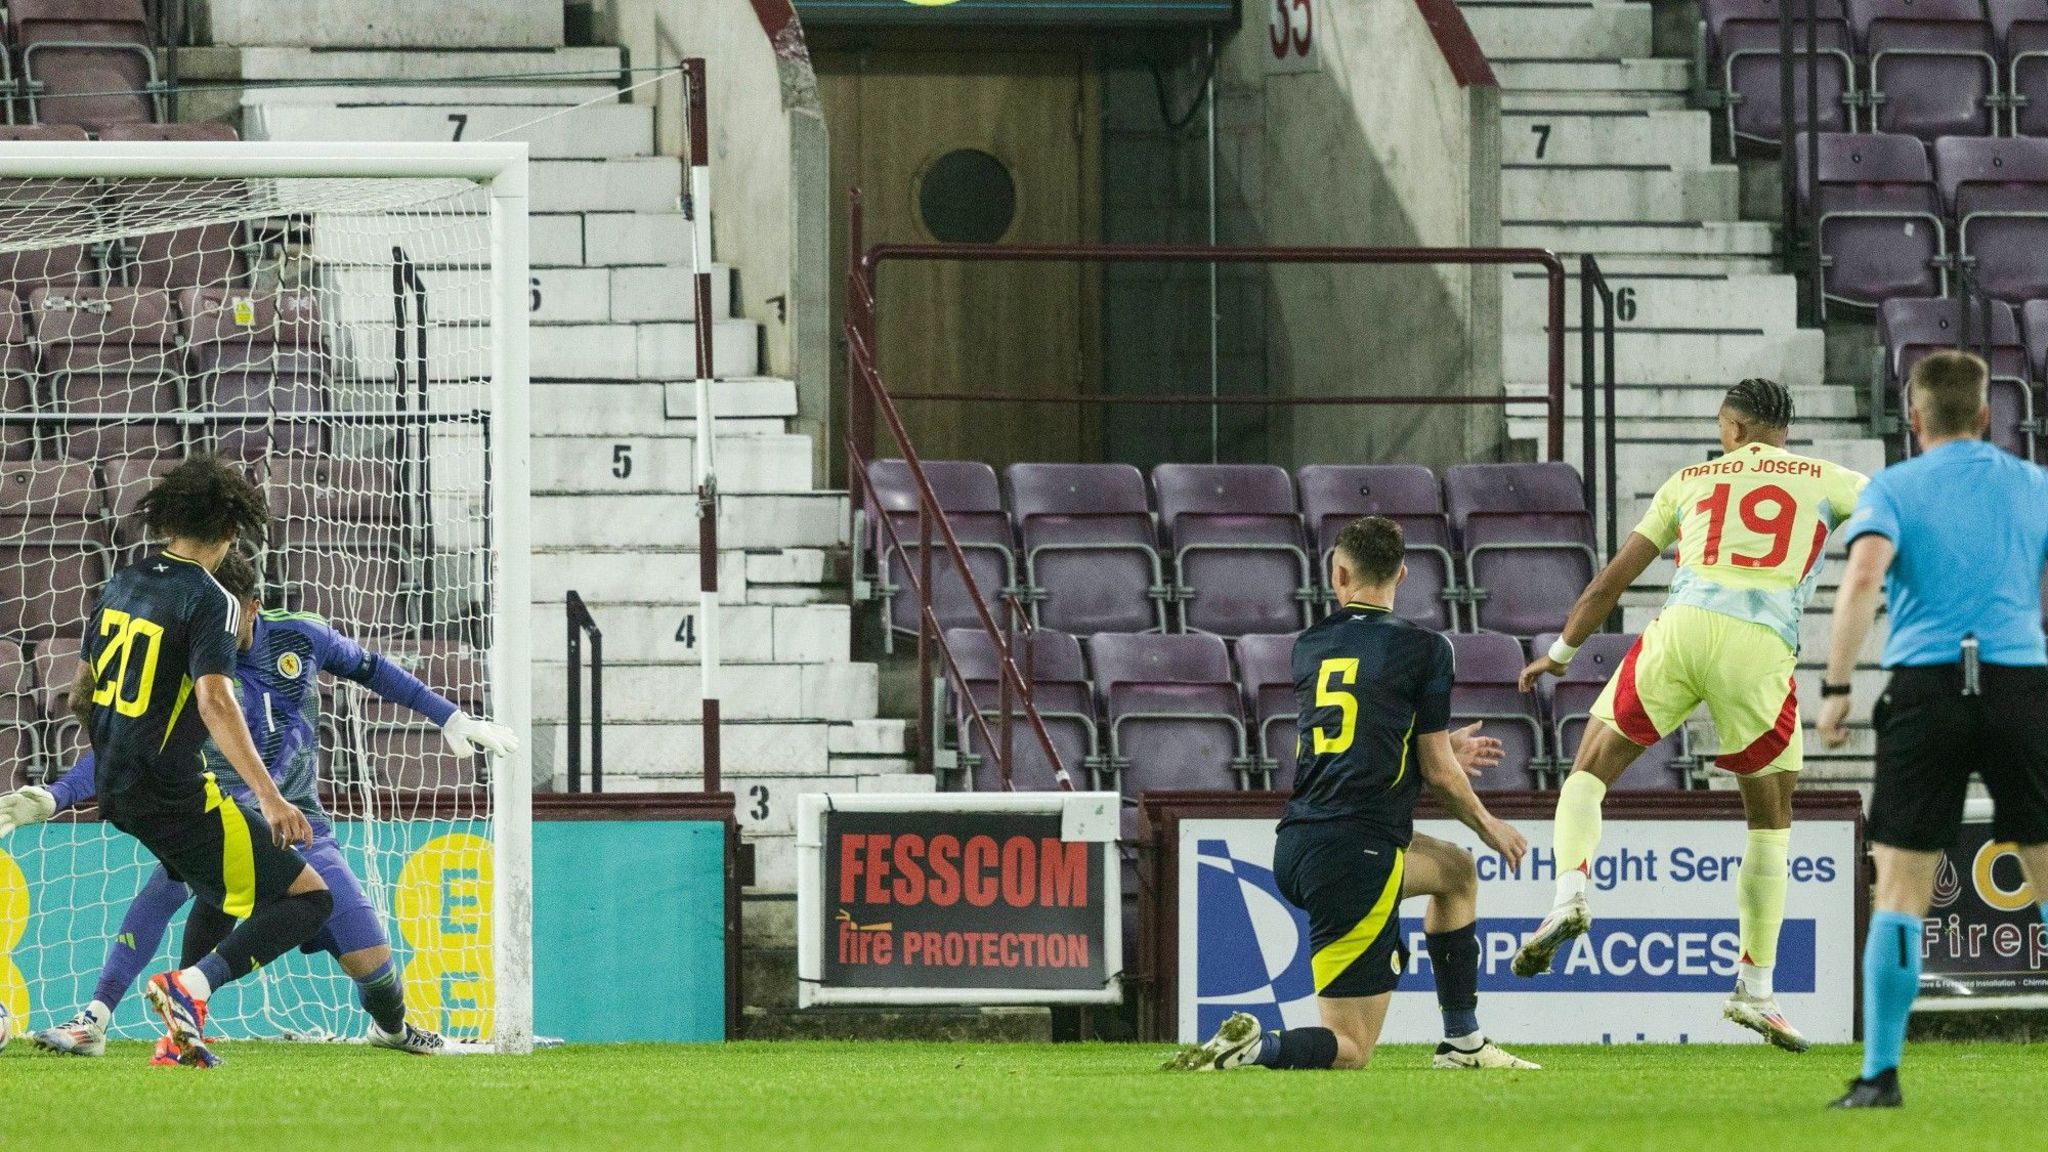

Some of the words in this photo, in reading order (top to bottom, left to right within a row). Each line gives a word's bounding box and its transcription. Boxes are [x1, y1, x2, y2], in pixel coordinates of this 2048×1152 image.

[448, 114, 468, 142] 7
[1531, 125, 1551, 159] 7
[1616, 287, 1637, 322] 6
[612, 444, 633, 480] 5
[1681, 460, 1744, 481] MATEO
[1750, 458, 1822, 479] JOSEPH
[1695, 482, 1798, 568] 19
[674, 614, 696, 649] 4
[91, 607, 165, 719] 20
[263, 691, 276, 733] 1
[1312, 657, 1360, 756] 5
[749, 785, 770, 821] 3
[839, 832, 1089, 908] FESSCOM
[1531, 847, 1658, 891] Hght
[838, 919, 893, 966] fire
[903, 930, 1090, 969] PROTECTION
[1563, 930, 1743, 976] ACCES
